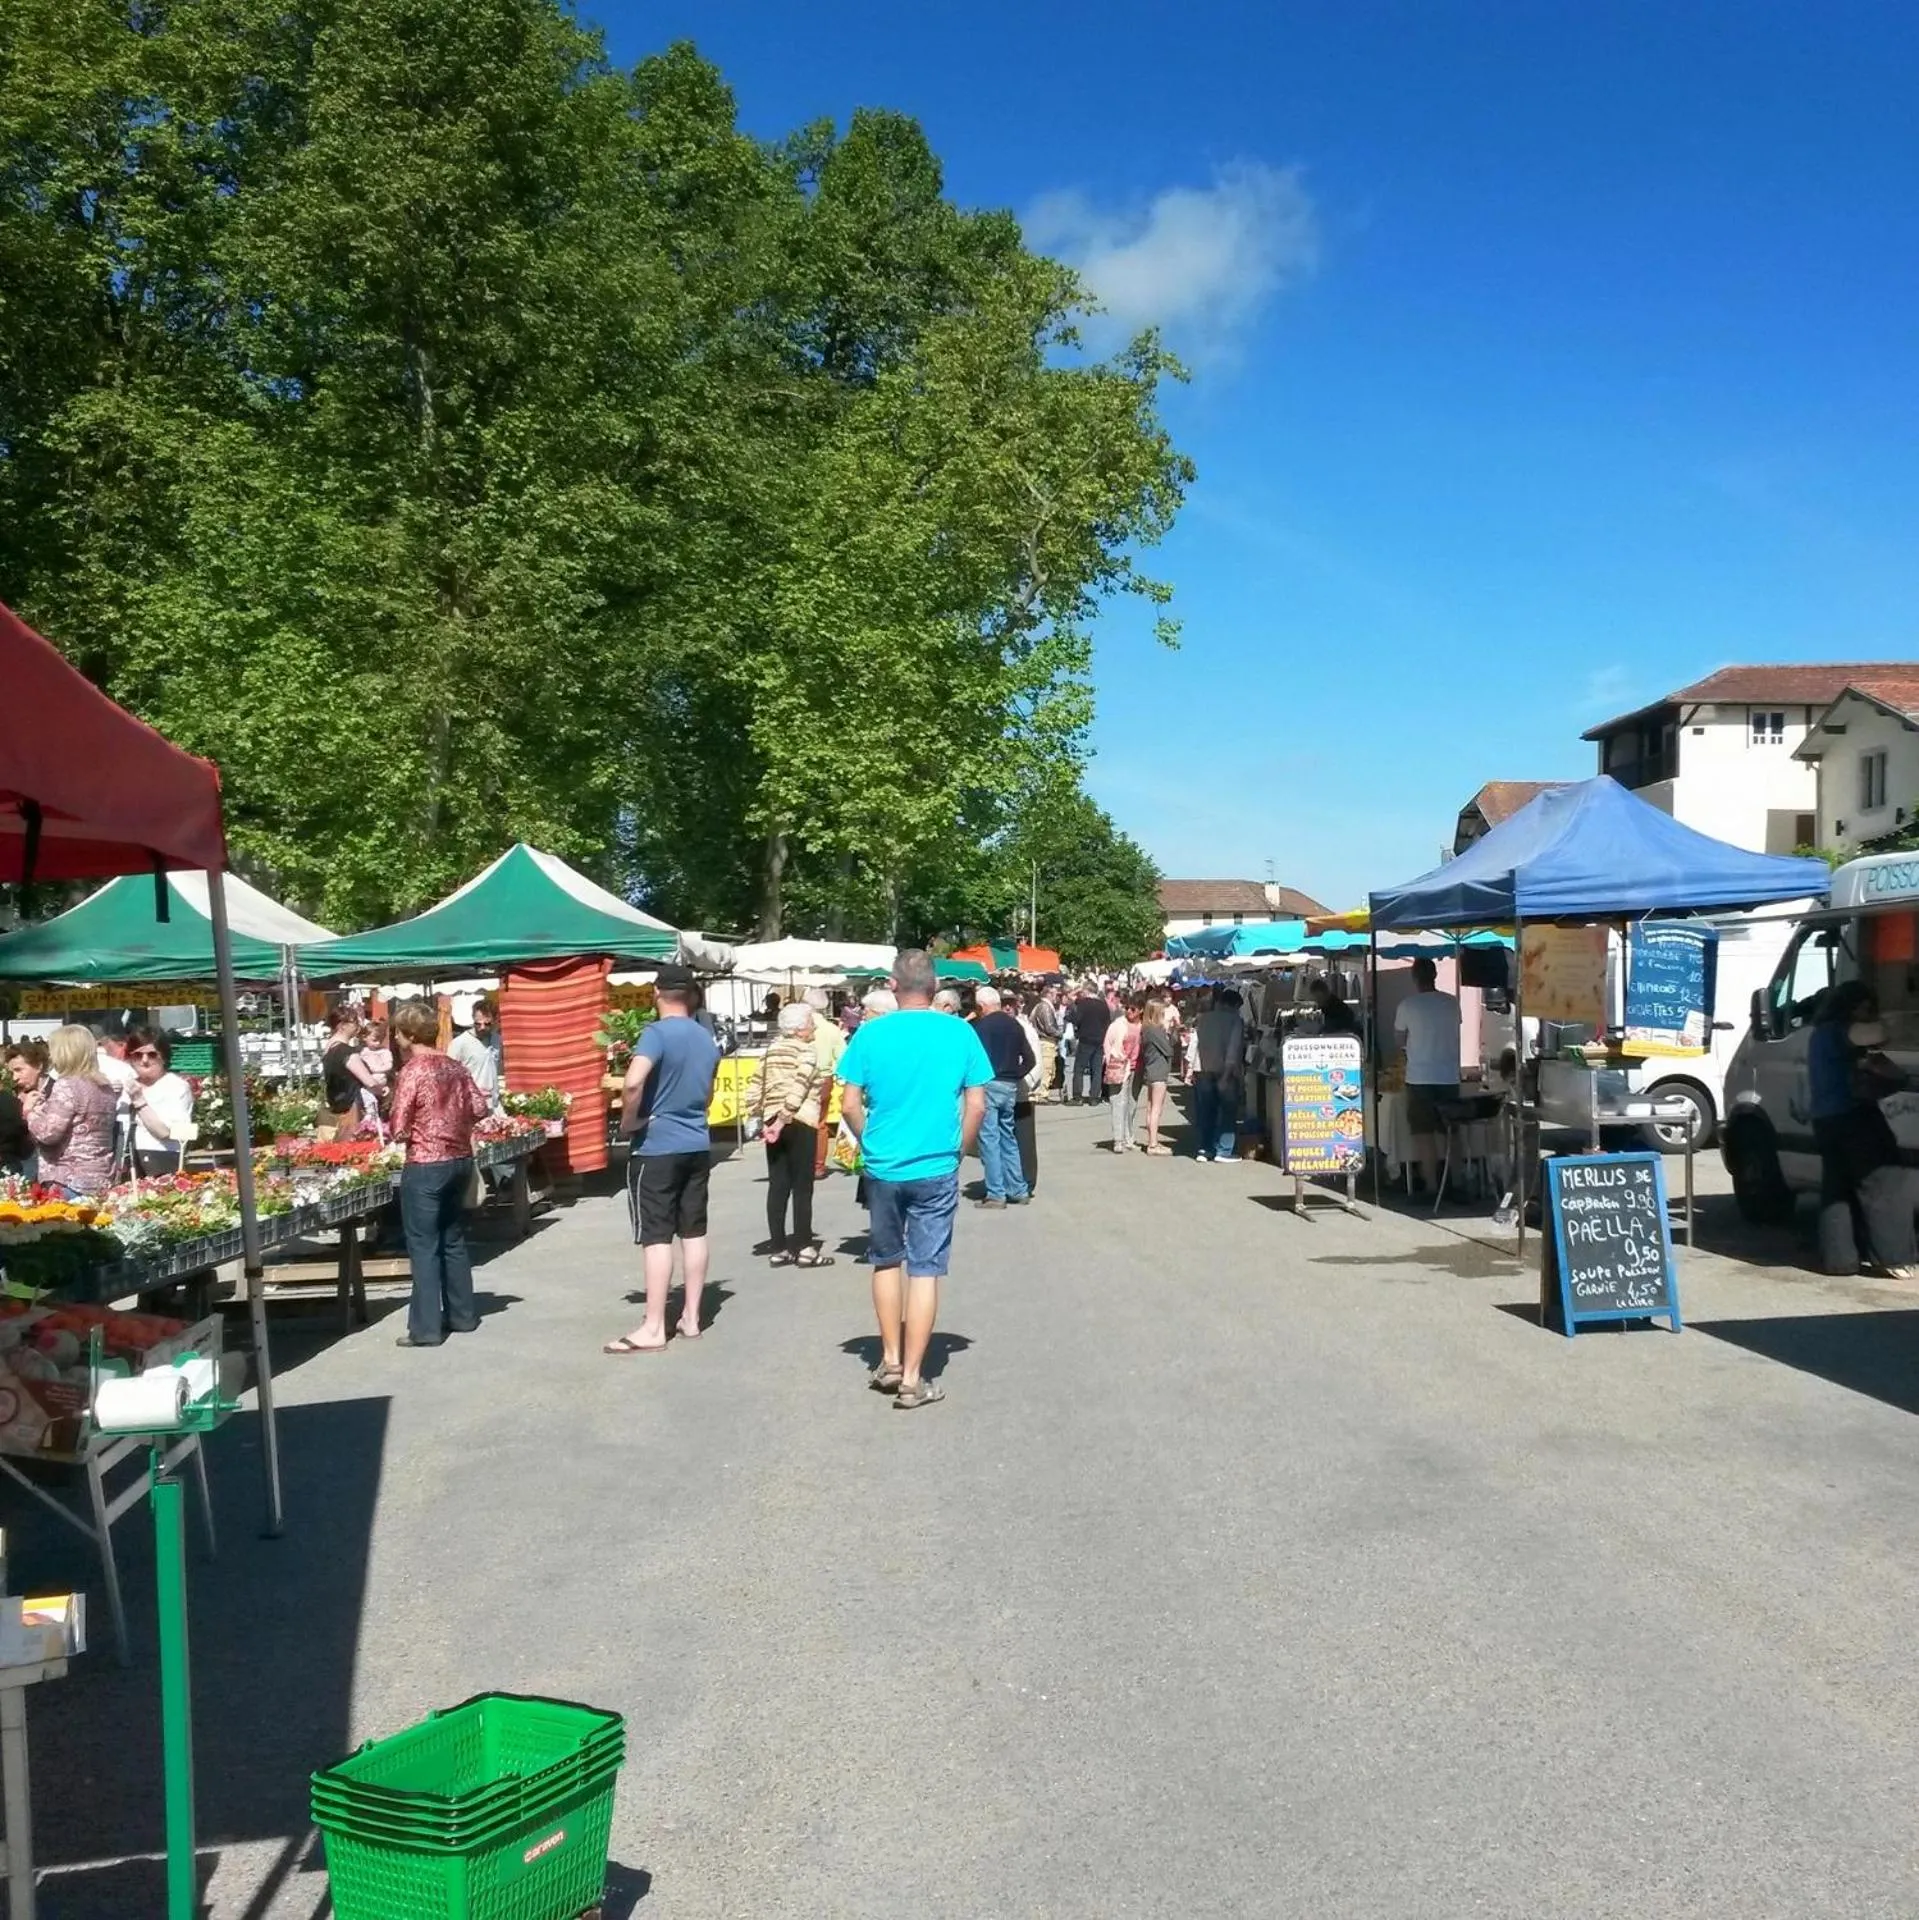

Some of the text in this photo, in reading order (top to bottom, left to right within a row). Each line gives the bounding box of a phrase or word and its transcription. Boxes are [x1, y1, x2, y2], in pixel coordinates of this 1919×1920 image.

[1287, 1044, 1355, 1052] POISSONNERIE
[1288, 1147, 1325, 1157] MOULES
[1561, 1167, 1652, 1191] MERLUS DE
[1567, 1214, 1645, 1247] PAËLLA
